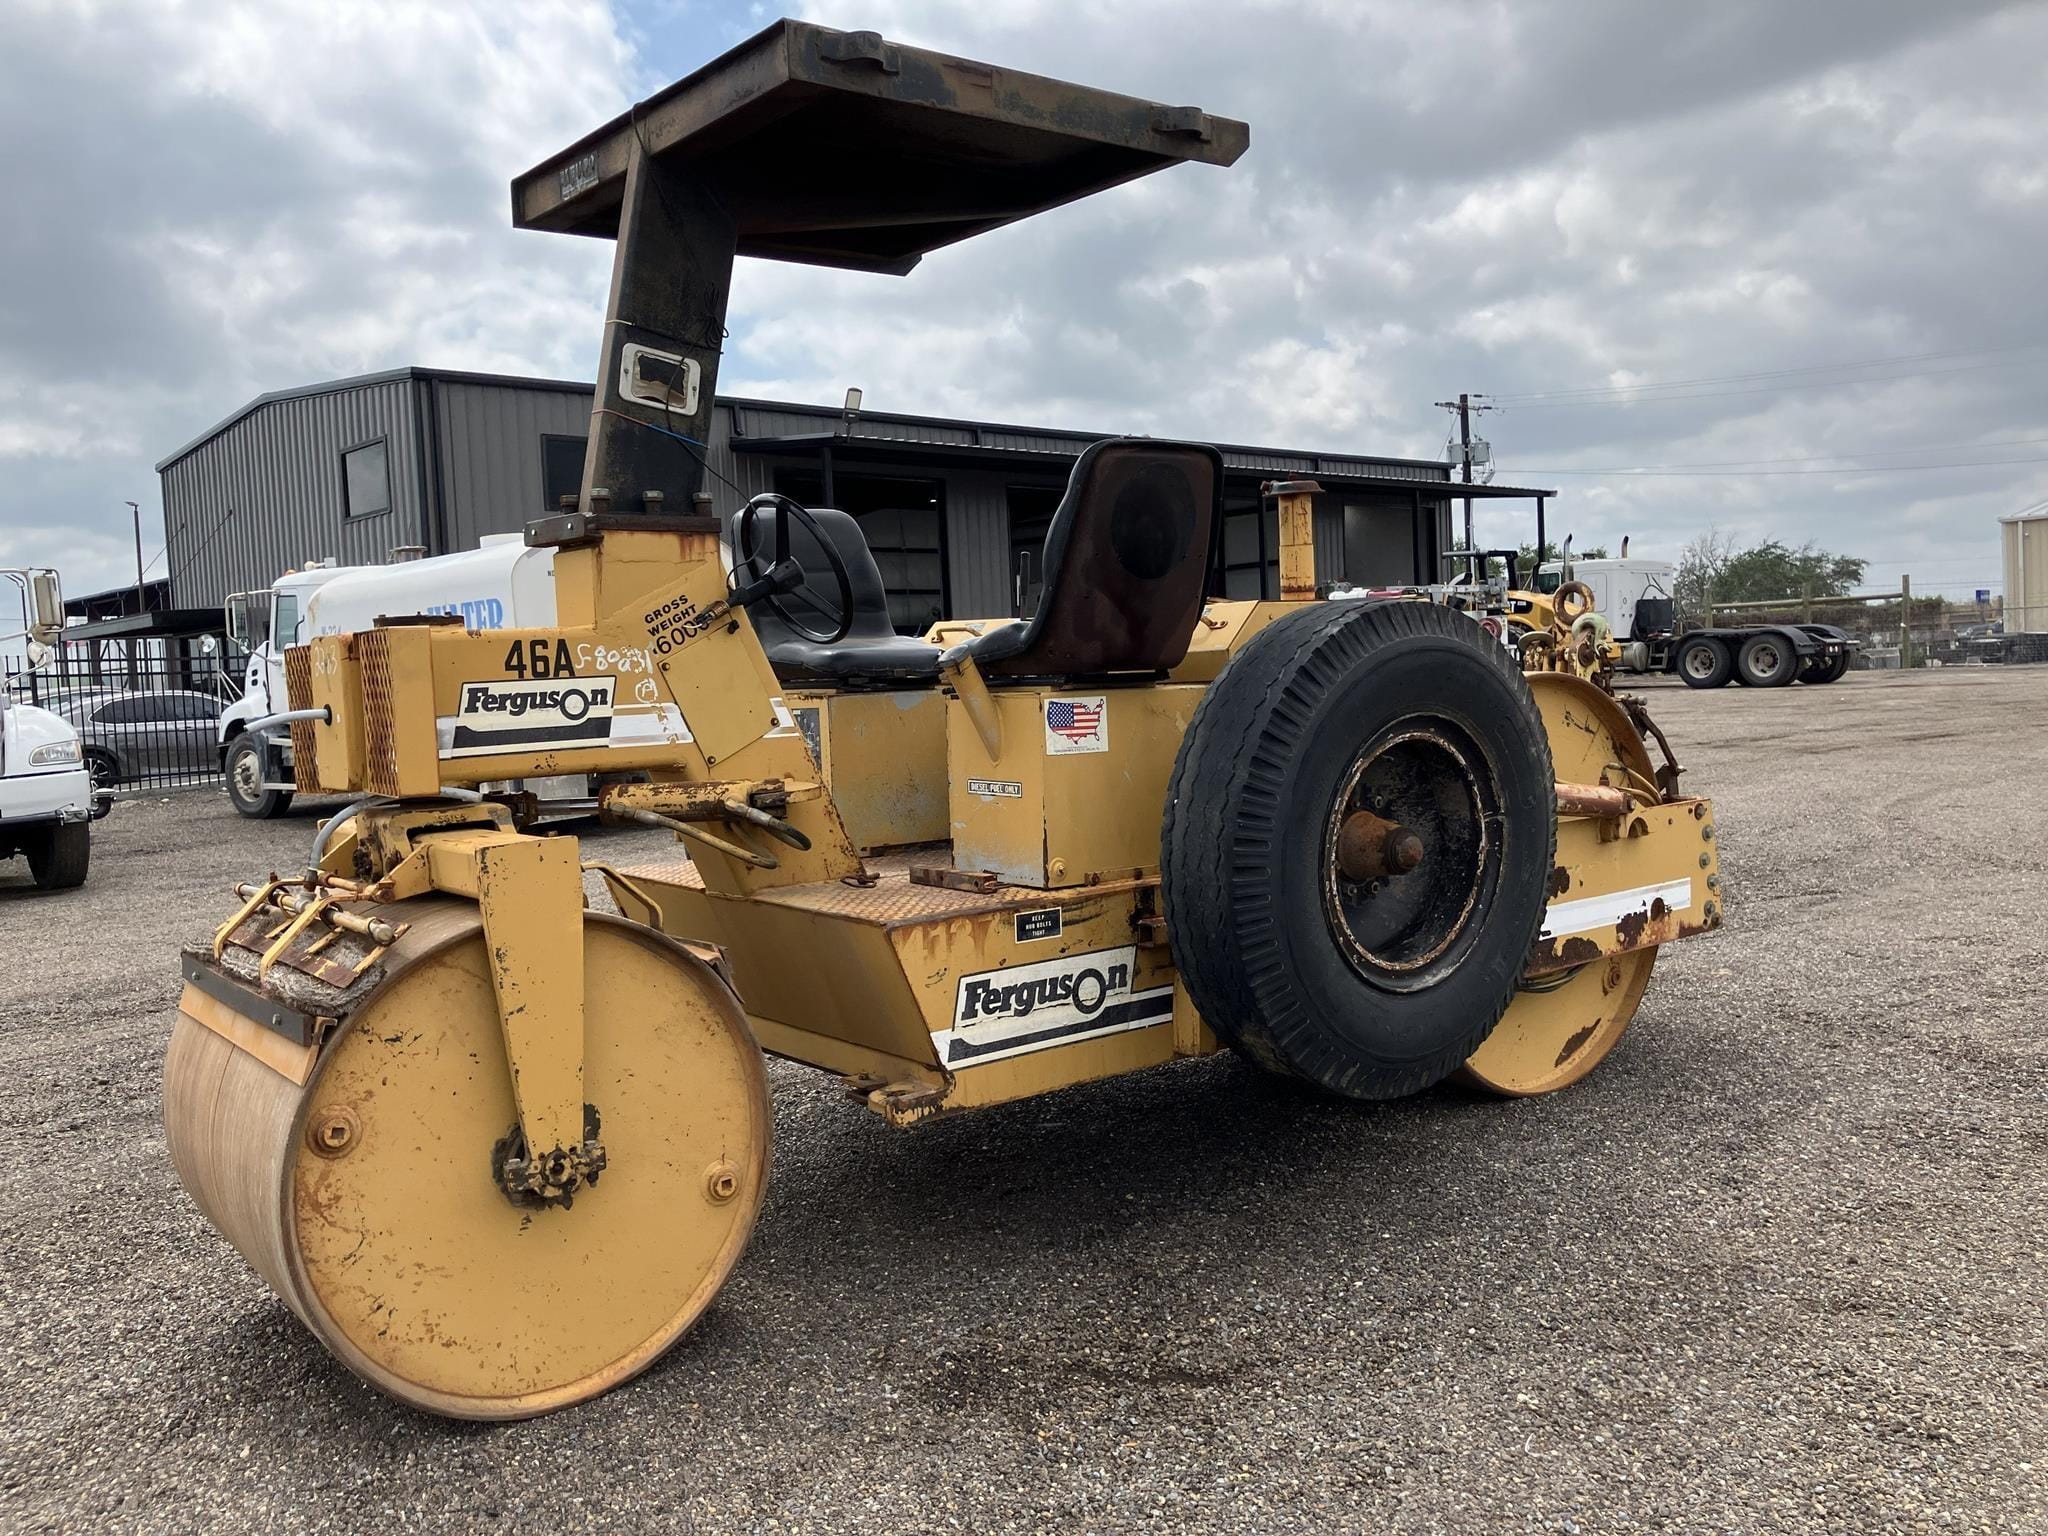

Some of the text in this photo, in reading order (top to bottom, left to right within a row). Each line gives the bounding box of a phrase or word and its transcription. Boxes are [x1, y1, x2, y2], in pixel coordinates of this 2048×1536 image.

[644, 594, 689, 624] GROSS
[647, 603, 697, 637] WEIGHT
[504, 638, 576, 679] 46A
[970, 782, 1019, 794] DIESEL FUEL ONLY
[1032, 929, 1045, 937] TIGHT
